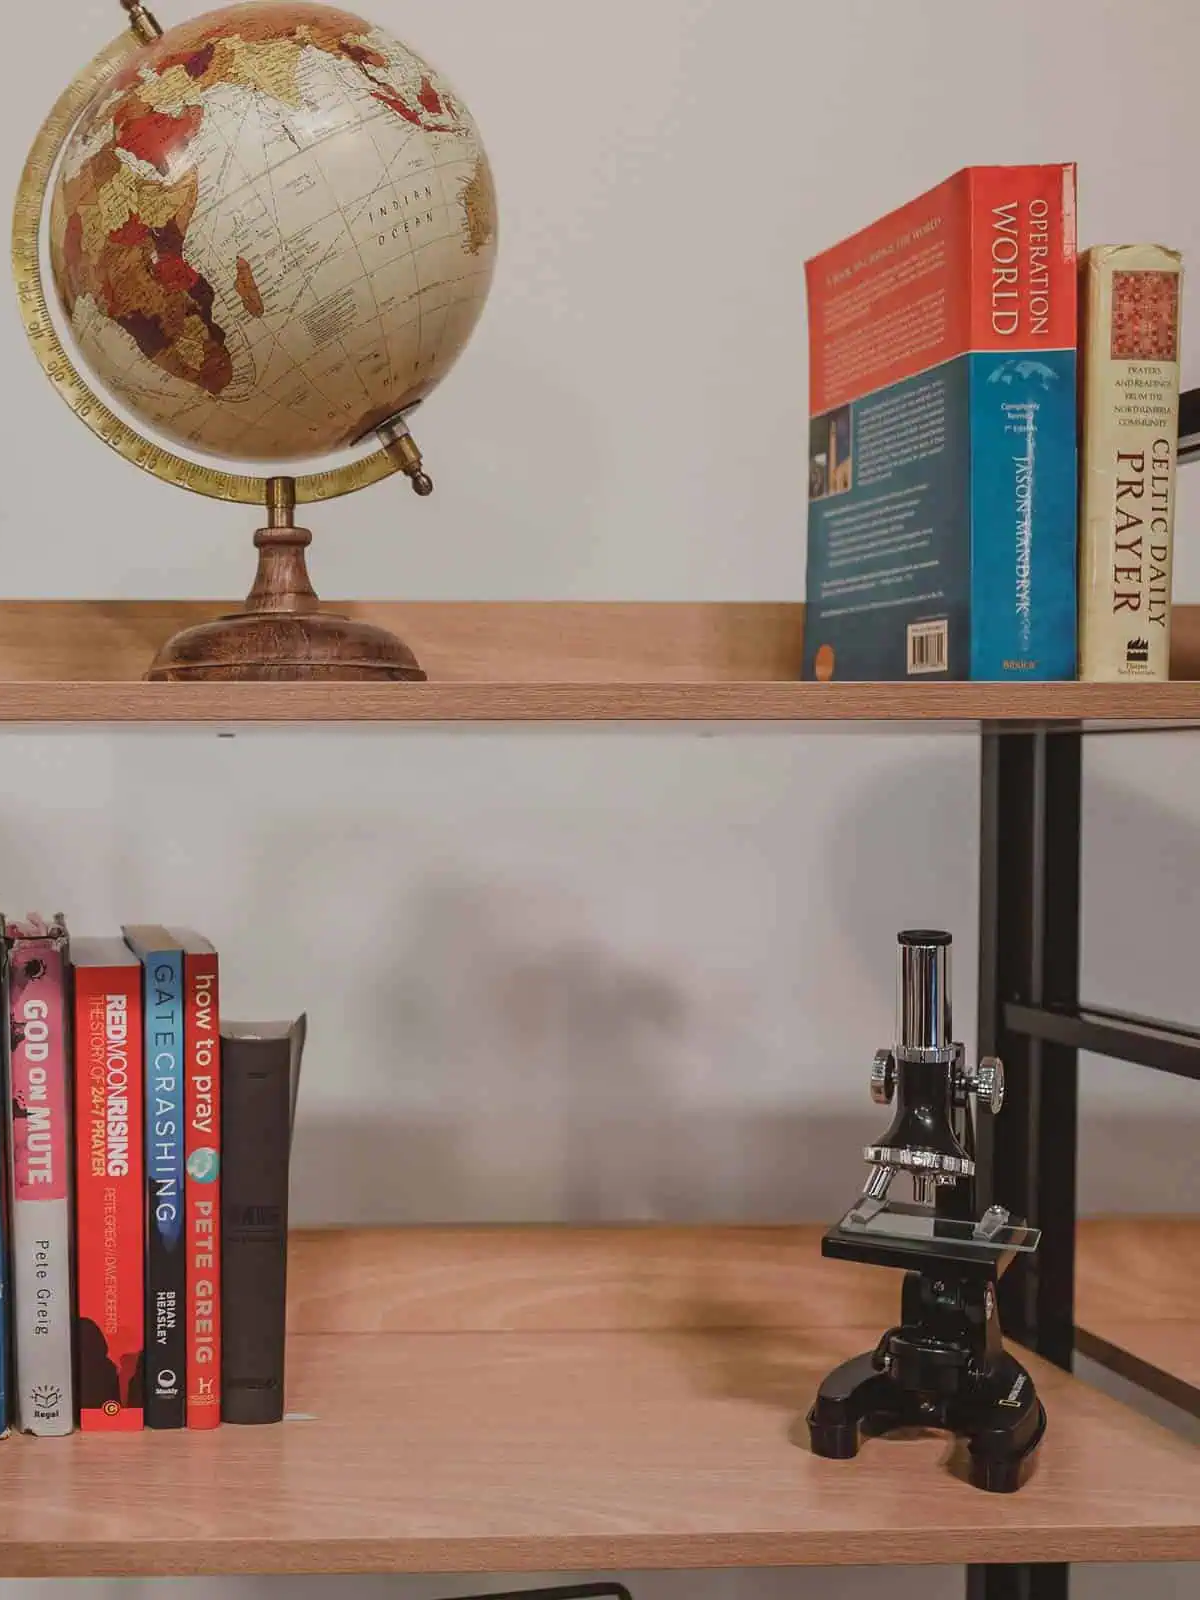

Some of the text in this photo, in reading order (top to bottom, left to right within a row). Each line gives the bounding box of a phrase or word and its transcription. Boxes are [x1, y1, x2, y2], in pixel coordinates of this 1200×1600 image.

[991, 200, 1019, 336] WORLD
[1028, 199, 1049, 335] OPERATION
[1012, 456, 1033, 513] JASON
[1112, 449, 1145, 615] PRAYER
[1148, 438, 1170, 628] CELTIC DAILY
[23, 999, 49, 1062] GOD
[192, 974, 215, 1133] how to pray
[26, 1106, 52, 1185] MUTE
[91, 1119, 106, 1177] PRAYER
[154, 963, 176, 1222] GATECRASHING
[34, 1240, 52, 1335] Pete Greig
[156, 1291, 167, 1345] HEASLEY
[166, 1291, 176, 1329] BRIAN
[194, 1200, 213, 1364] PETE GREIG
